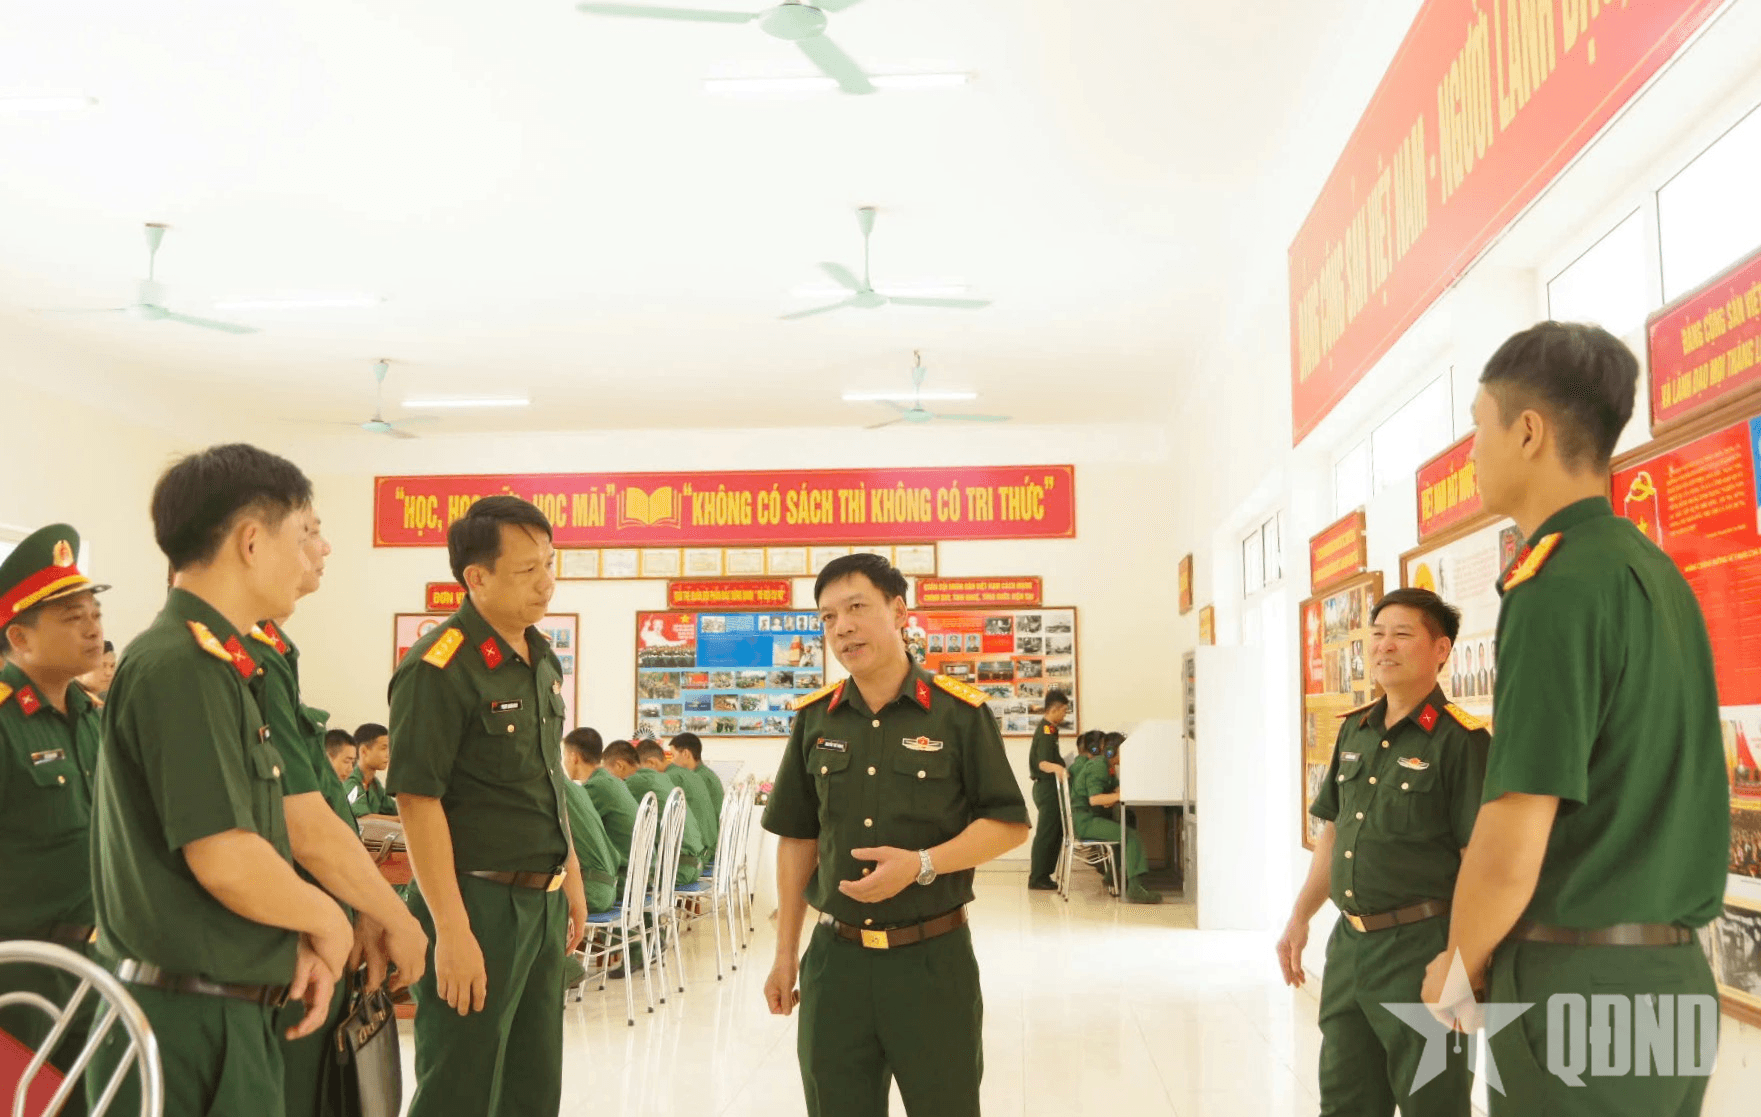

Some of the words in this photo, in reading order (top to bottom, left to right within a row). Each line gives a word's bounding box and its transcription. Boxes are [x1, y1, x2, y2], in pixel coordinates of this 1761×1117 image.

[1367, 154, 1392, 306] VIỆT
[1394, 113, 1427, 262] NAM
[1437, 0, 1493, 204] NGƯỜI
[1746, 281, 1761, 320] VIỆ
[757, 483, 781, 525] CÓ
[786, 482, 834, 524] SÁCH
[839, 482, 866, 523] THÌ
[871, 481, 931, 523] KHÔNG
[937, 480, 961, 522] CÓ
[966, 486, 994, 521] TRI
